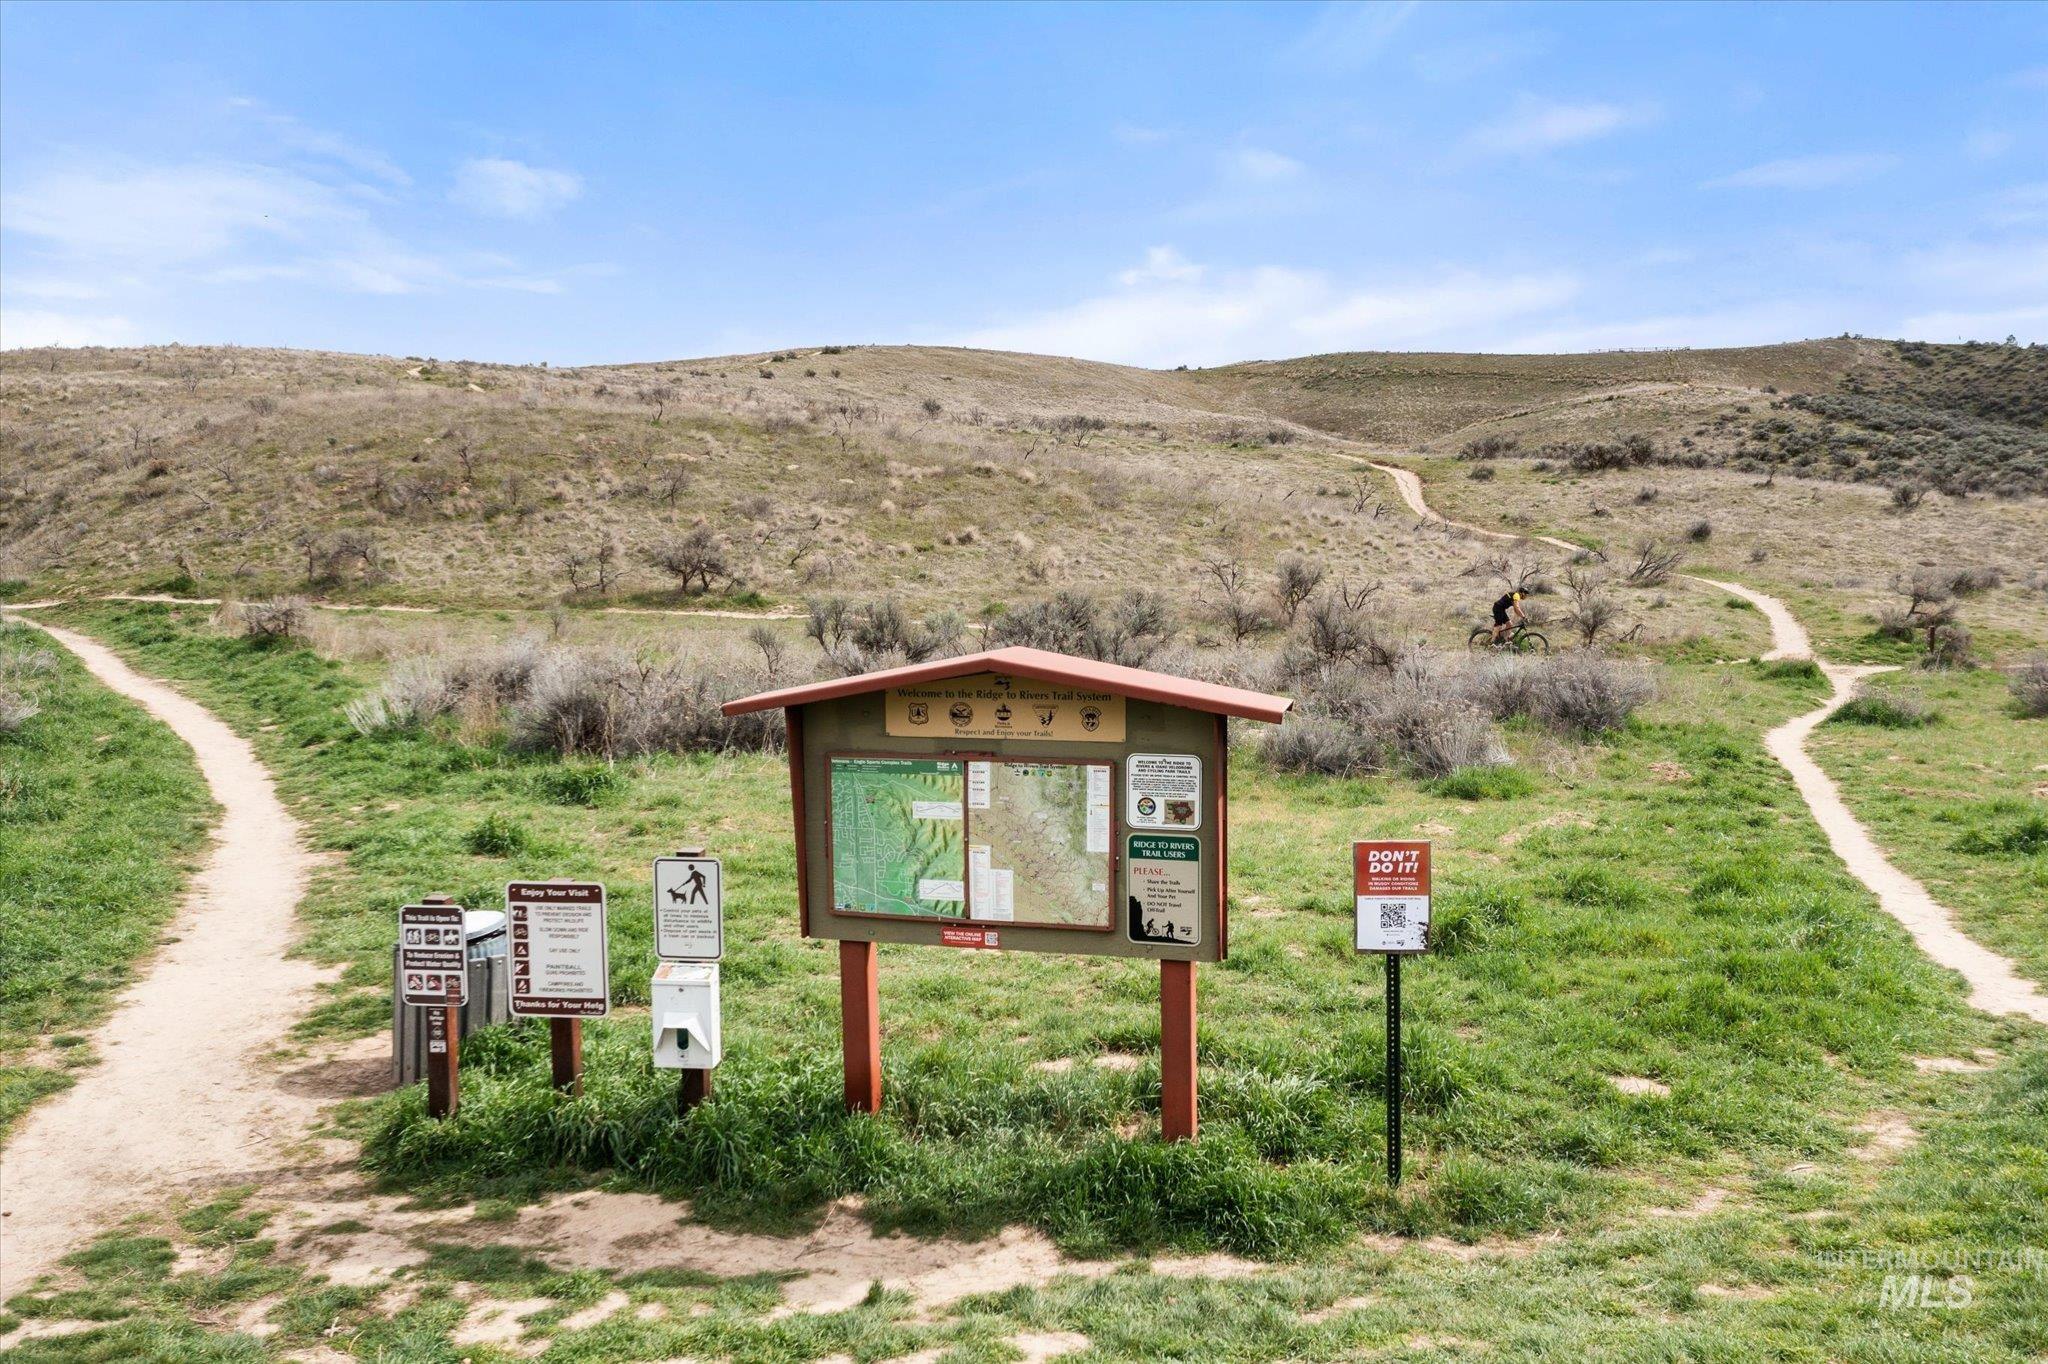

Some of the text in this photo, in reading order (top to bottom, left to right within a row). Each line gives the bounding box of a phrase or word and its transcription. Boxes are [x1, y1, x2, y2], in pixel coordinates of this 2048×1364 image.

[898, 688, 1111, 701] Welcome to the Ridge to Rivers Trail System
[997, 729, 1014, 737] Enjoy
[1133, 841, 1195, 850] RIDGE TO RIVERS
[1368, 850, 1420, 862] DON'T
[1369, 862, 1419, 873] DO IT!
[521, 888, 589, 897] Enjoy Your Visit
[514, 1000, 546, 1009] Thanks
[548, 1000, 560, 1008] for
[562, 1001, 582, 1009] Your
